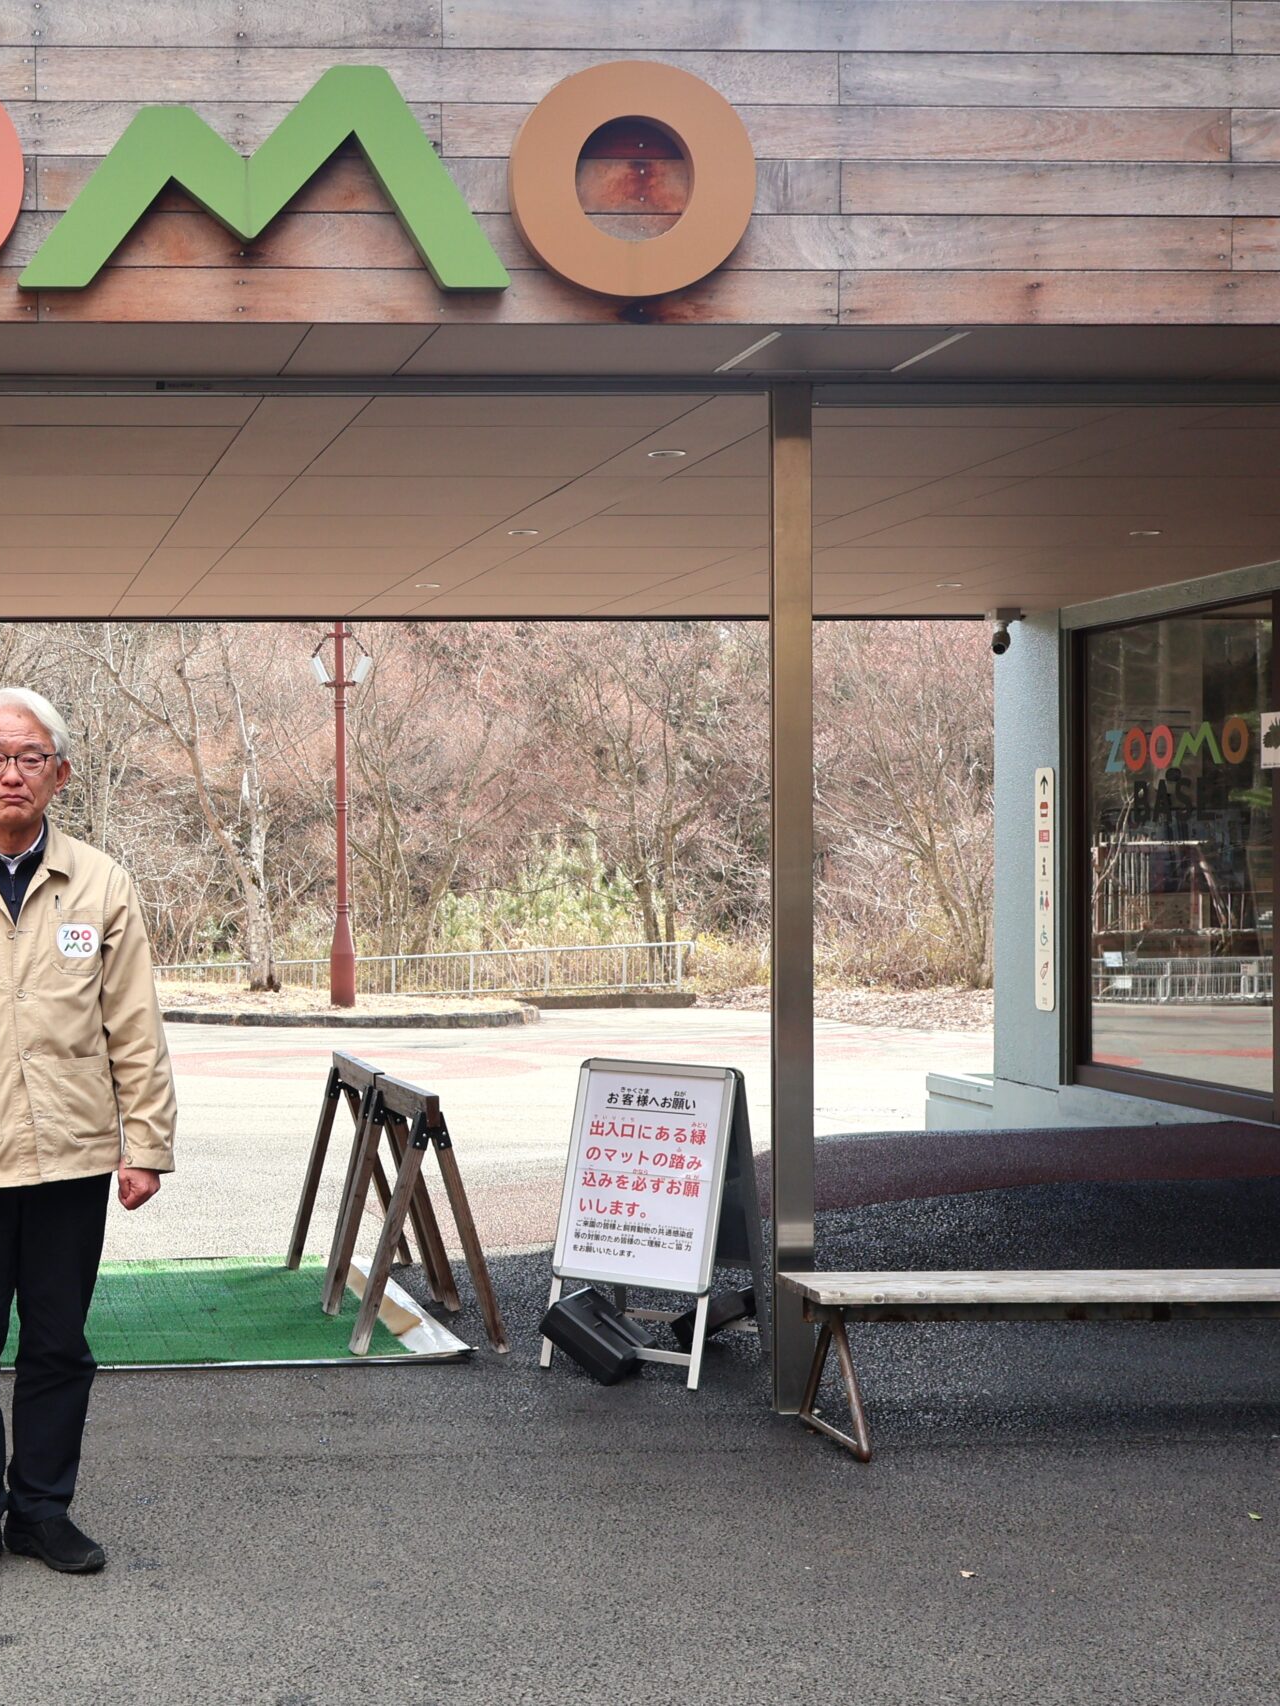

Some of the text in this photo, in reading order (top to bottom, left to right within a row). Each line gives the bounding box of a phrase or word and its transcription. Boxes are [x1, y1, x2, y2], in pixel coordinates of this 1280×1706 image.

[1104, 716, 1249, 773] ZOOMO
[63, 929, 91, 940] ZOO
[64, 941, 93, 952] MO
[607, 1092, 696, 1110] お客様へお願い
[589, 1120, 707, 1145] 出入口にある緑
[586, 1146, 702, 1171] のマットの踏み
[582, 1171, 700, 1198] 込みを必ずお願
[579, 1198, 647, 1219] いします。
